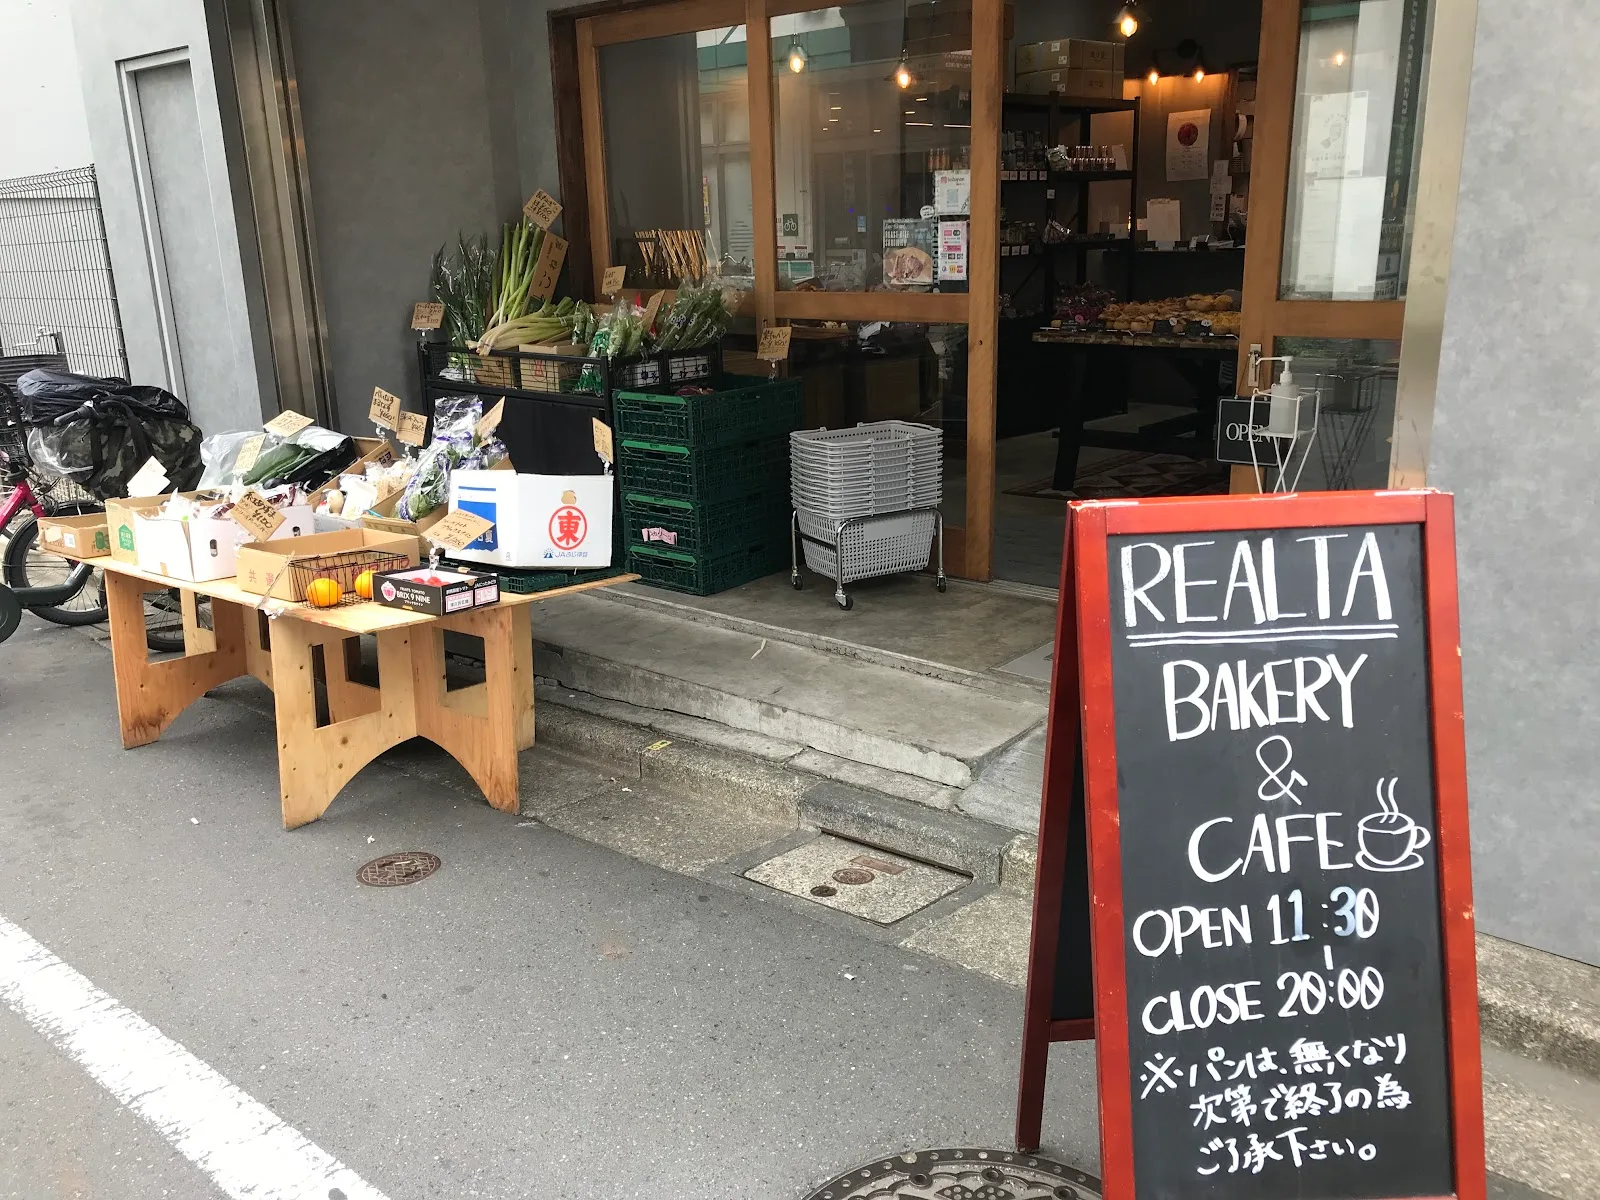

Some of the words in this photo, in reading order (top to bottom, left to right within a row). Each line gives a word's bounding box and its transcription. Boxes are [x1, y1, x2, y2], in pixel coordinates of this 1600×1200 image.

[556, 510, 582, 547] 東
[396, 590, 410, 600] BRIX
[410, 592, 415, 600] 9
[415, 593, 431, 604] NINE
[1121, 532, 1393, 628] REALTA
[1162, 653, 1369, 742] BAKERY
[1255, 734, 1309, 806] &
[1187, 812, 1354, 883] CAFE
[1132, 904, 1253, 957] OPEN
[1141, 980, 1266, 1036] CLOSE
[1276, 965, 1385, 1019] 20:00
[1189, 1073, 1413, 1131] 次第で終了の為
[1197, 1126, 1378, 1175] ご了承下さい。
